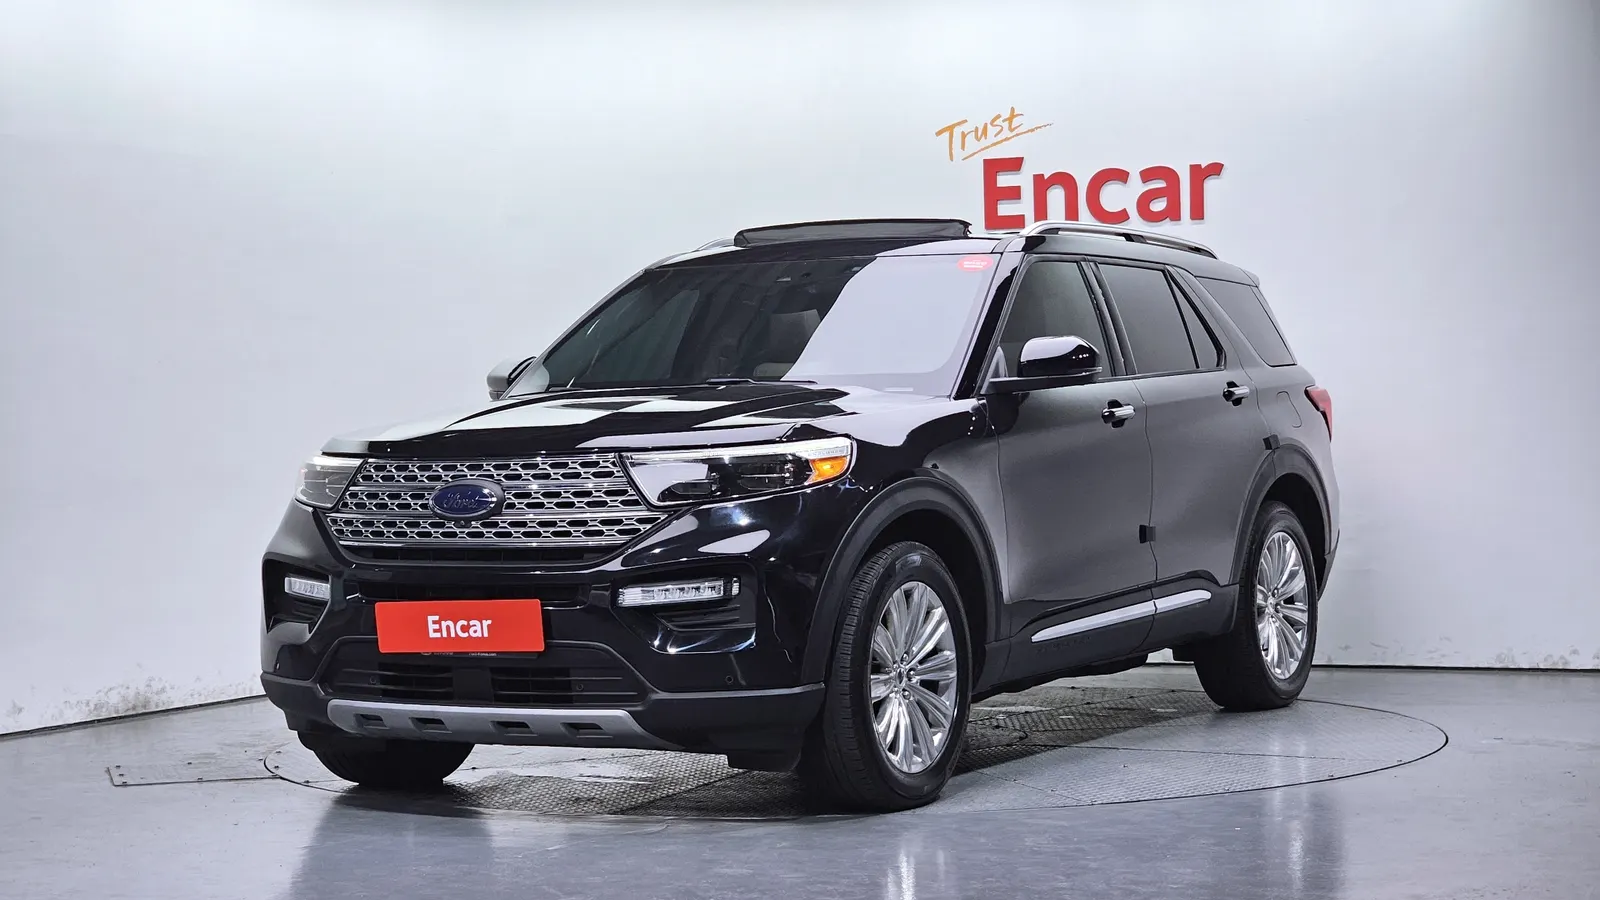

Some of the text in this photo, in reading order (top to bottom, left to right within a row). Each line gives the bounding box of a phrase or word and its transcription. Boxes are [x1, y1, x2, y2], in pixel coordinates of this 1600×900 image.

[935, 106, 1024, 162] Trust
[983, 157, 1224, 230] Encar
[427, 615, 492, 638] Encar
